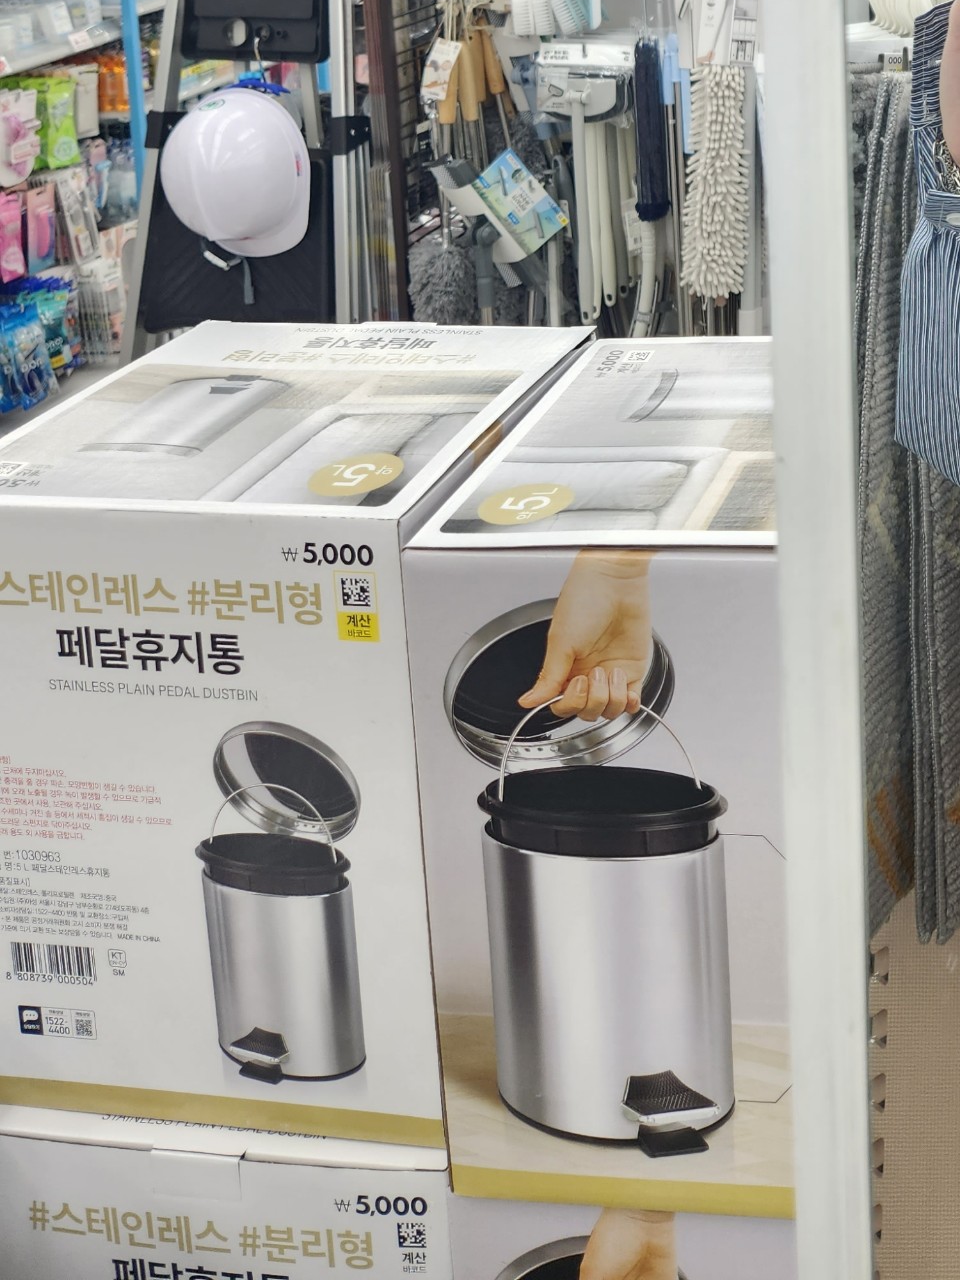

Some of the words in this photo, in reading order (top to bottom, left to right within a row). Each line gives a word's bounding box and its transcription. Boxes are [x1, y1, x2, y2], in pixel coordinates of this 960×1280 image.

[386, 327, 421, 335] PLAIN
[421, 328, 484, 336] STAINLESS
[302, 335, 439, 350] 페달휴지통
[302, 542, 374, 567] 5,000
[187, 579, 323, 626] #분리형
[346, 614, 371, 628] 계산
[347, 628, 372, 640] 바코드
[56, 626, 244, 676] 페달휴지통
[49, 679, 115, 694] STAINLESS
[118, 681, 155, 696] PLAIN
[159, 684, 200, 699] PEDAL
[203, 687, 259, 701] DUSTBIN
[119, 784, 126, 792] 수
[117, 933, 134, 941] MADE
[142, 935, 161, 943] CHINA
[6, 971, 12, 980] 8
[17, 972, 53, 983] 808739
[58, 975, 94, 986] 000504
[112, 968, 126, 977] SM
[48, 1025, 71, 1035] 4400
[354, 1194, 428, 1217] 5,000
[29, 1200, 231, 1254] #스테인레스
[239, 1224, 374, 1270] #분리형
[401, 1251, 427, 1265] 계산
[402, 1265, 427, 1274] 바코드
